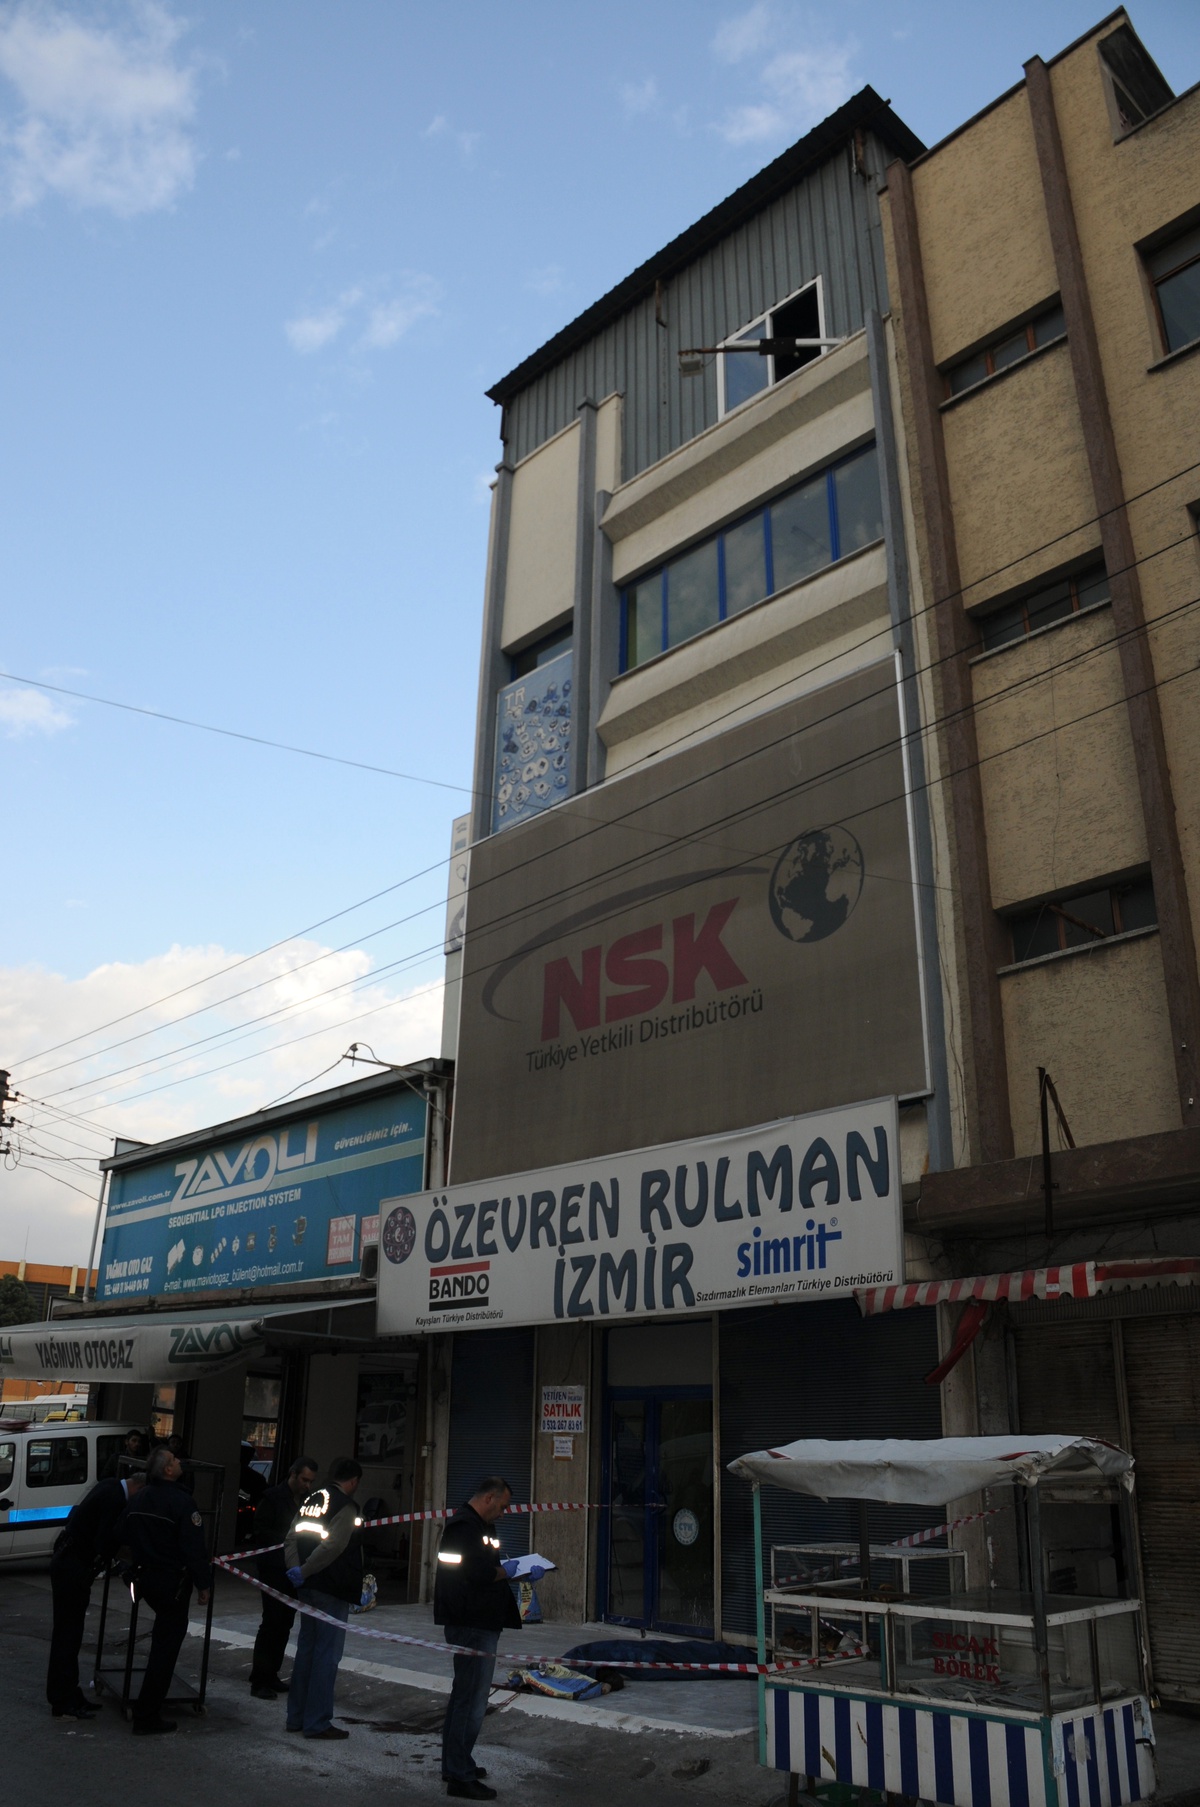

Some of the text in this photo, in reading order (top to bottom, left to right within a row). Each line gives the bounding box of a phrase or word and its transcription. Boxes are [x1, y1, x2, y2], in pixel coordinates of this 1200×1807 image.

[504, 686, 526, 710] TR
[540, 897, 749, 1042] NSK
[526, 989, 764, 1072] Türkiye Yetkili Distribütörü
[334, 1127, 388, 1150] GÜVENLİĞİNİZ
[170, 1121, 319, 1213] ZAVOLI
[110, 1190, 172, 1211] www.zavoli.com.tr
[168, 1188, 302, 1228] SEQUENTIAL LPG INJECTION SYSTEM
[424, 1176, 620, 1264] ÖZEVREN
[640, 1125, 890, 1234] RULMAN
[333, 1234, 351, 1245] TAM
[736, 1219, 842, 1278] simrit
[105, 1256, 154, 1280] YAĞMUR OTO GAZ
[553, 1228, 696, 1319] İZMİR
[429, 1273, 490, 1300] BANDO
[696, 1270, 894, 1302] Sızdırmazlık Elemanları Türkiye Distribütörü
[415, 1310, 504, 1327] Kayışları Türkiye Distribütörü
[35, 1336, 83, 1369] YAĞMUR
[84, 1339, 134, 1369] OTOGAZ
[543, 1403, 582, 1417] SATILIK
[546, 1420, 556, 1430] 532
[575, 1420, 582, 1430] 61
[932, 1632, 1000, 1656] SICAK
[933, 1655, 1001, 1687] BÖREK
